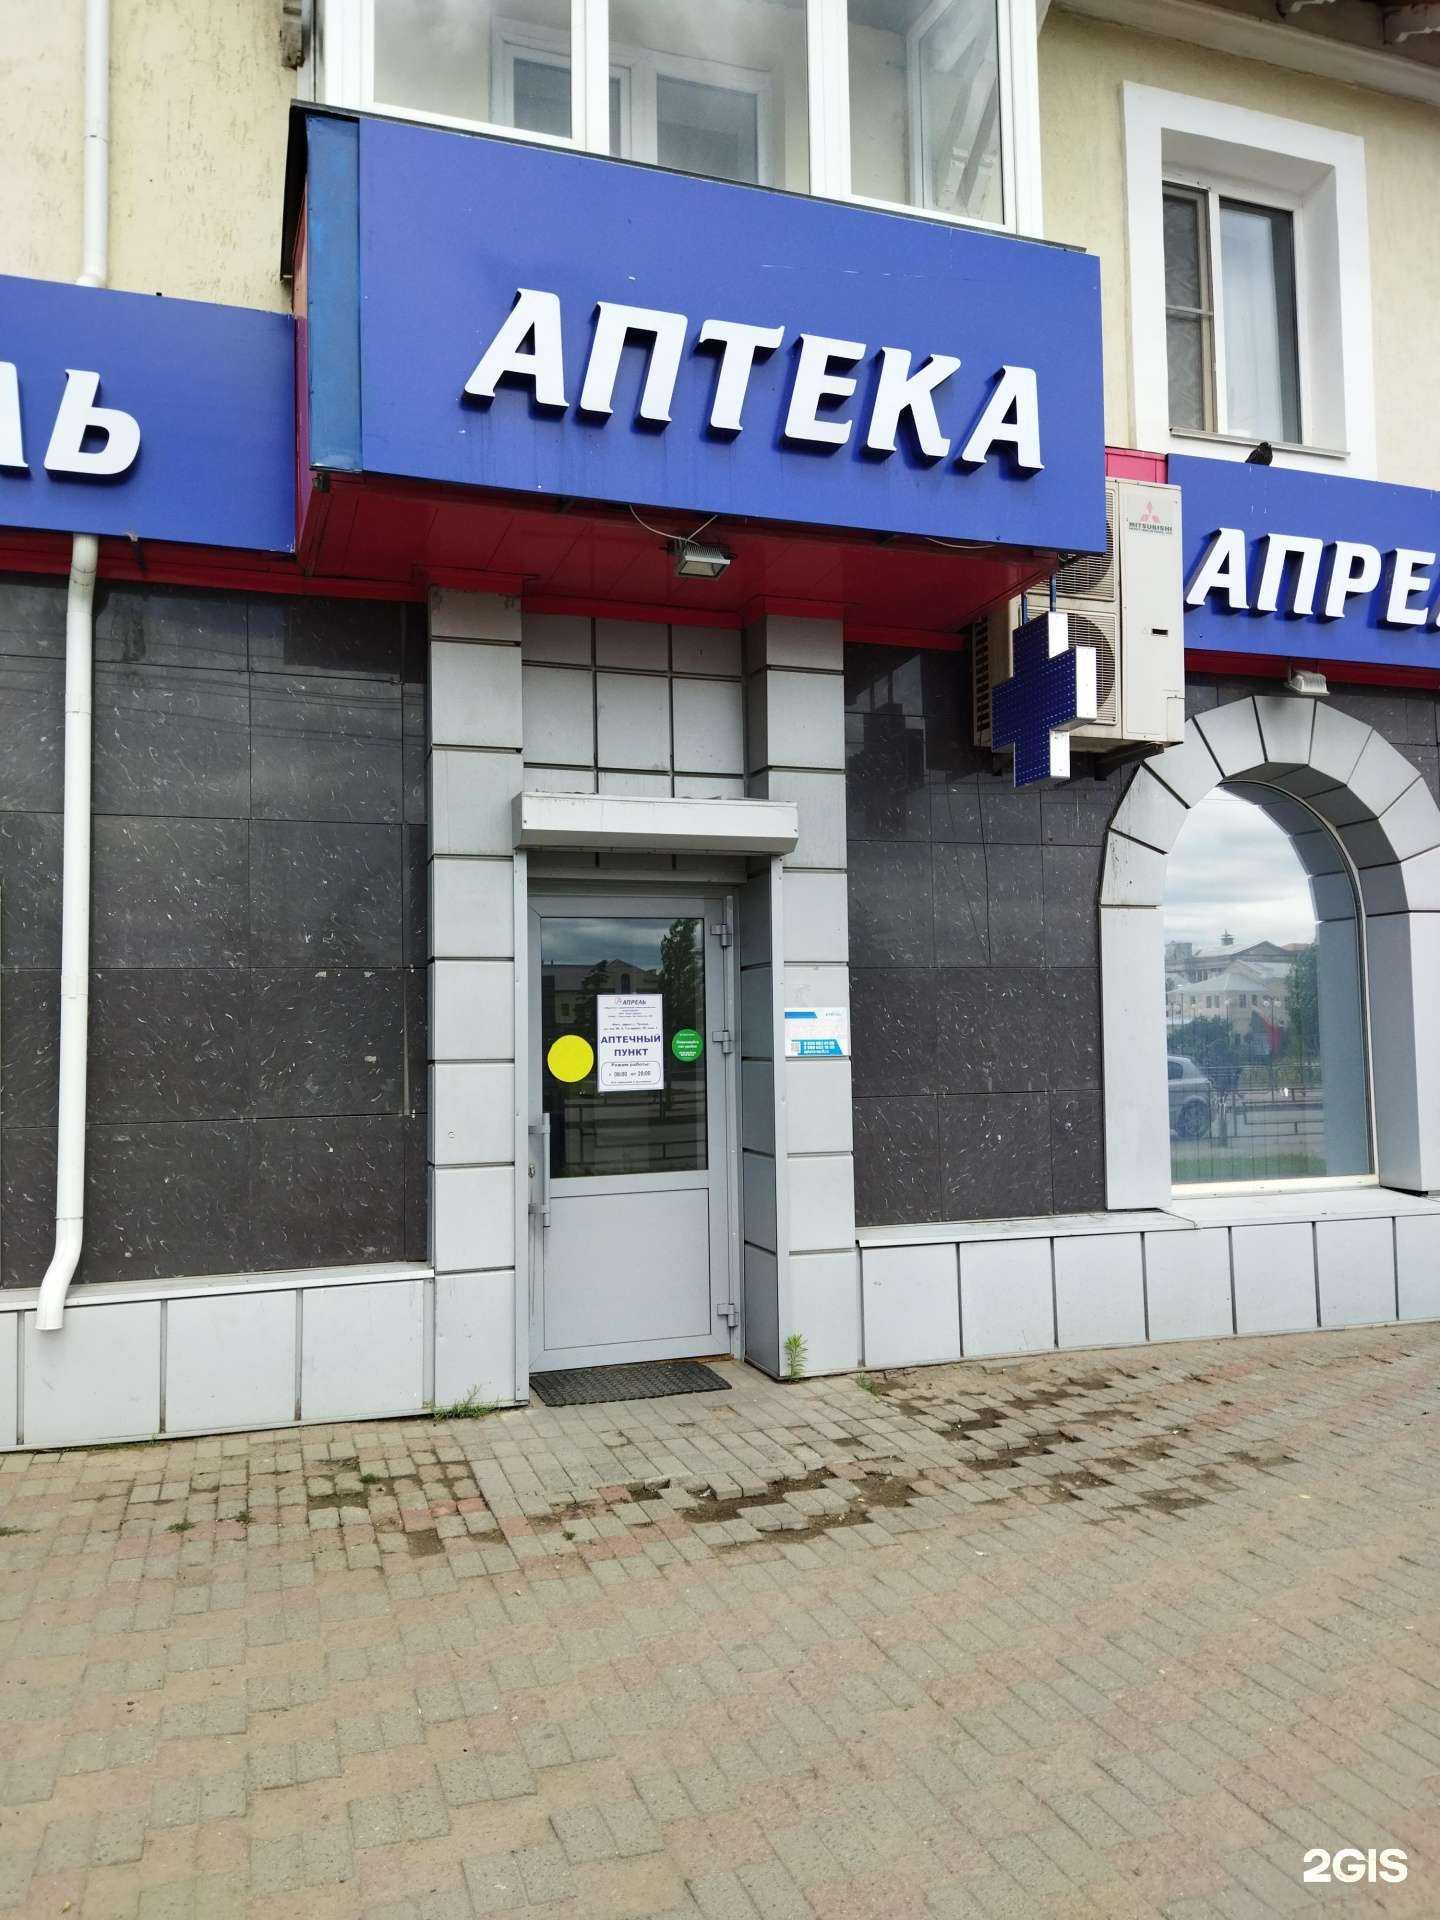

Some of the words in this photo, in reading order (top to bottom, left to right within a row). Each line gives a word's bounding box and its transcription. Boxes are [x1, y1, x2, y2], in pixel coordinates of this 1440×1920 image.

[464, 288, 1044, 470] АПТЕКА
[1128, 522, 1173, 532] MITSUBISHI
[1186, 527, 1440, 627] АПРЕ
[600, 1033, 661, 1043] АПТЕЧНЫЙ
[614, 1048, 648, 1056] ПУНКТ
